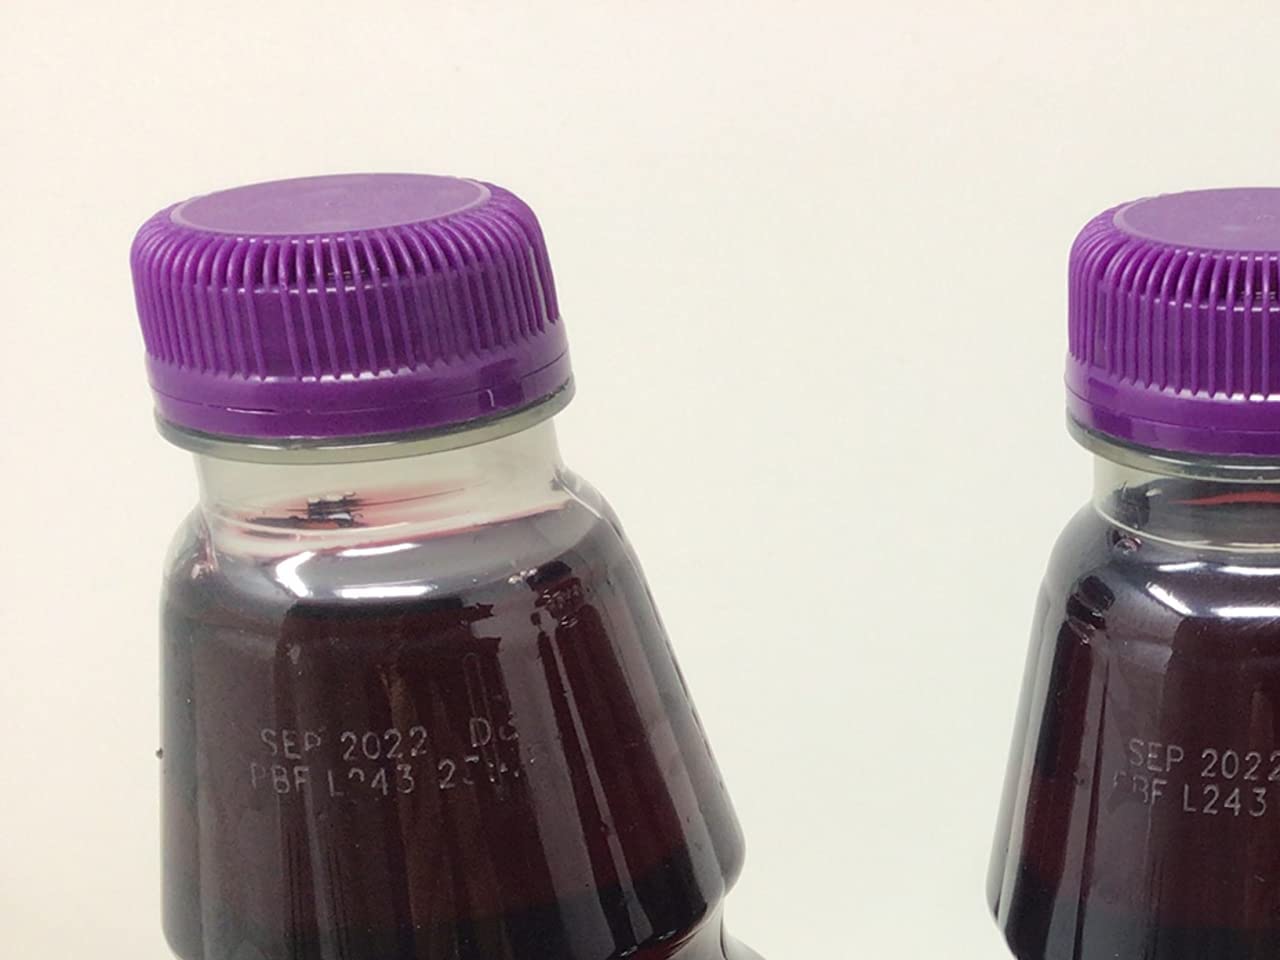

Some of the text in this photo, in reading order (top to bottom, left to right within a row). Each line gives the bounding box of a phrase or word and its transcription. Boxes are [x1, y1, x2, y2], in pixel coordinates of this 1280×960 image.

[260, 728, 325, 760] SEP
[340, 724, 428, 761] 2022
[1128, 738, 1184, 773] SEP
[1183, 784, 1268, 817] L243
